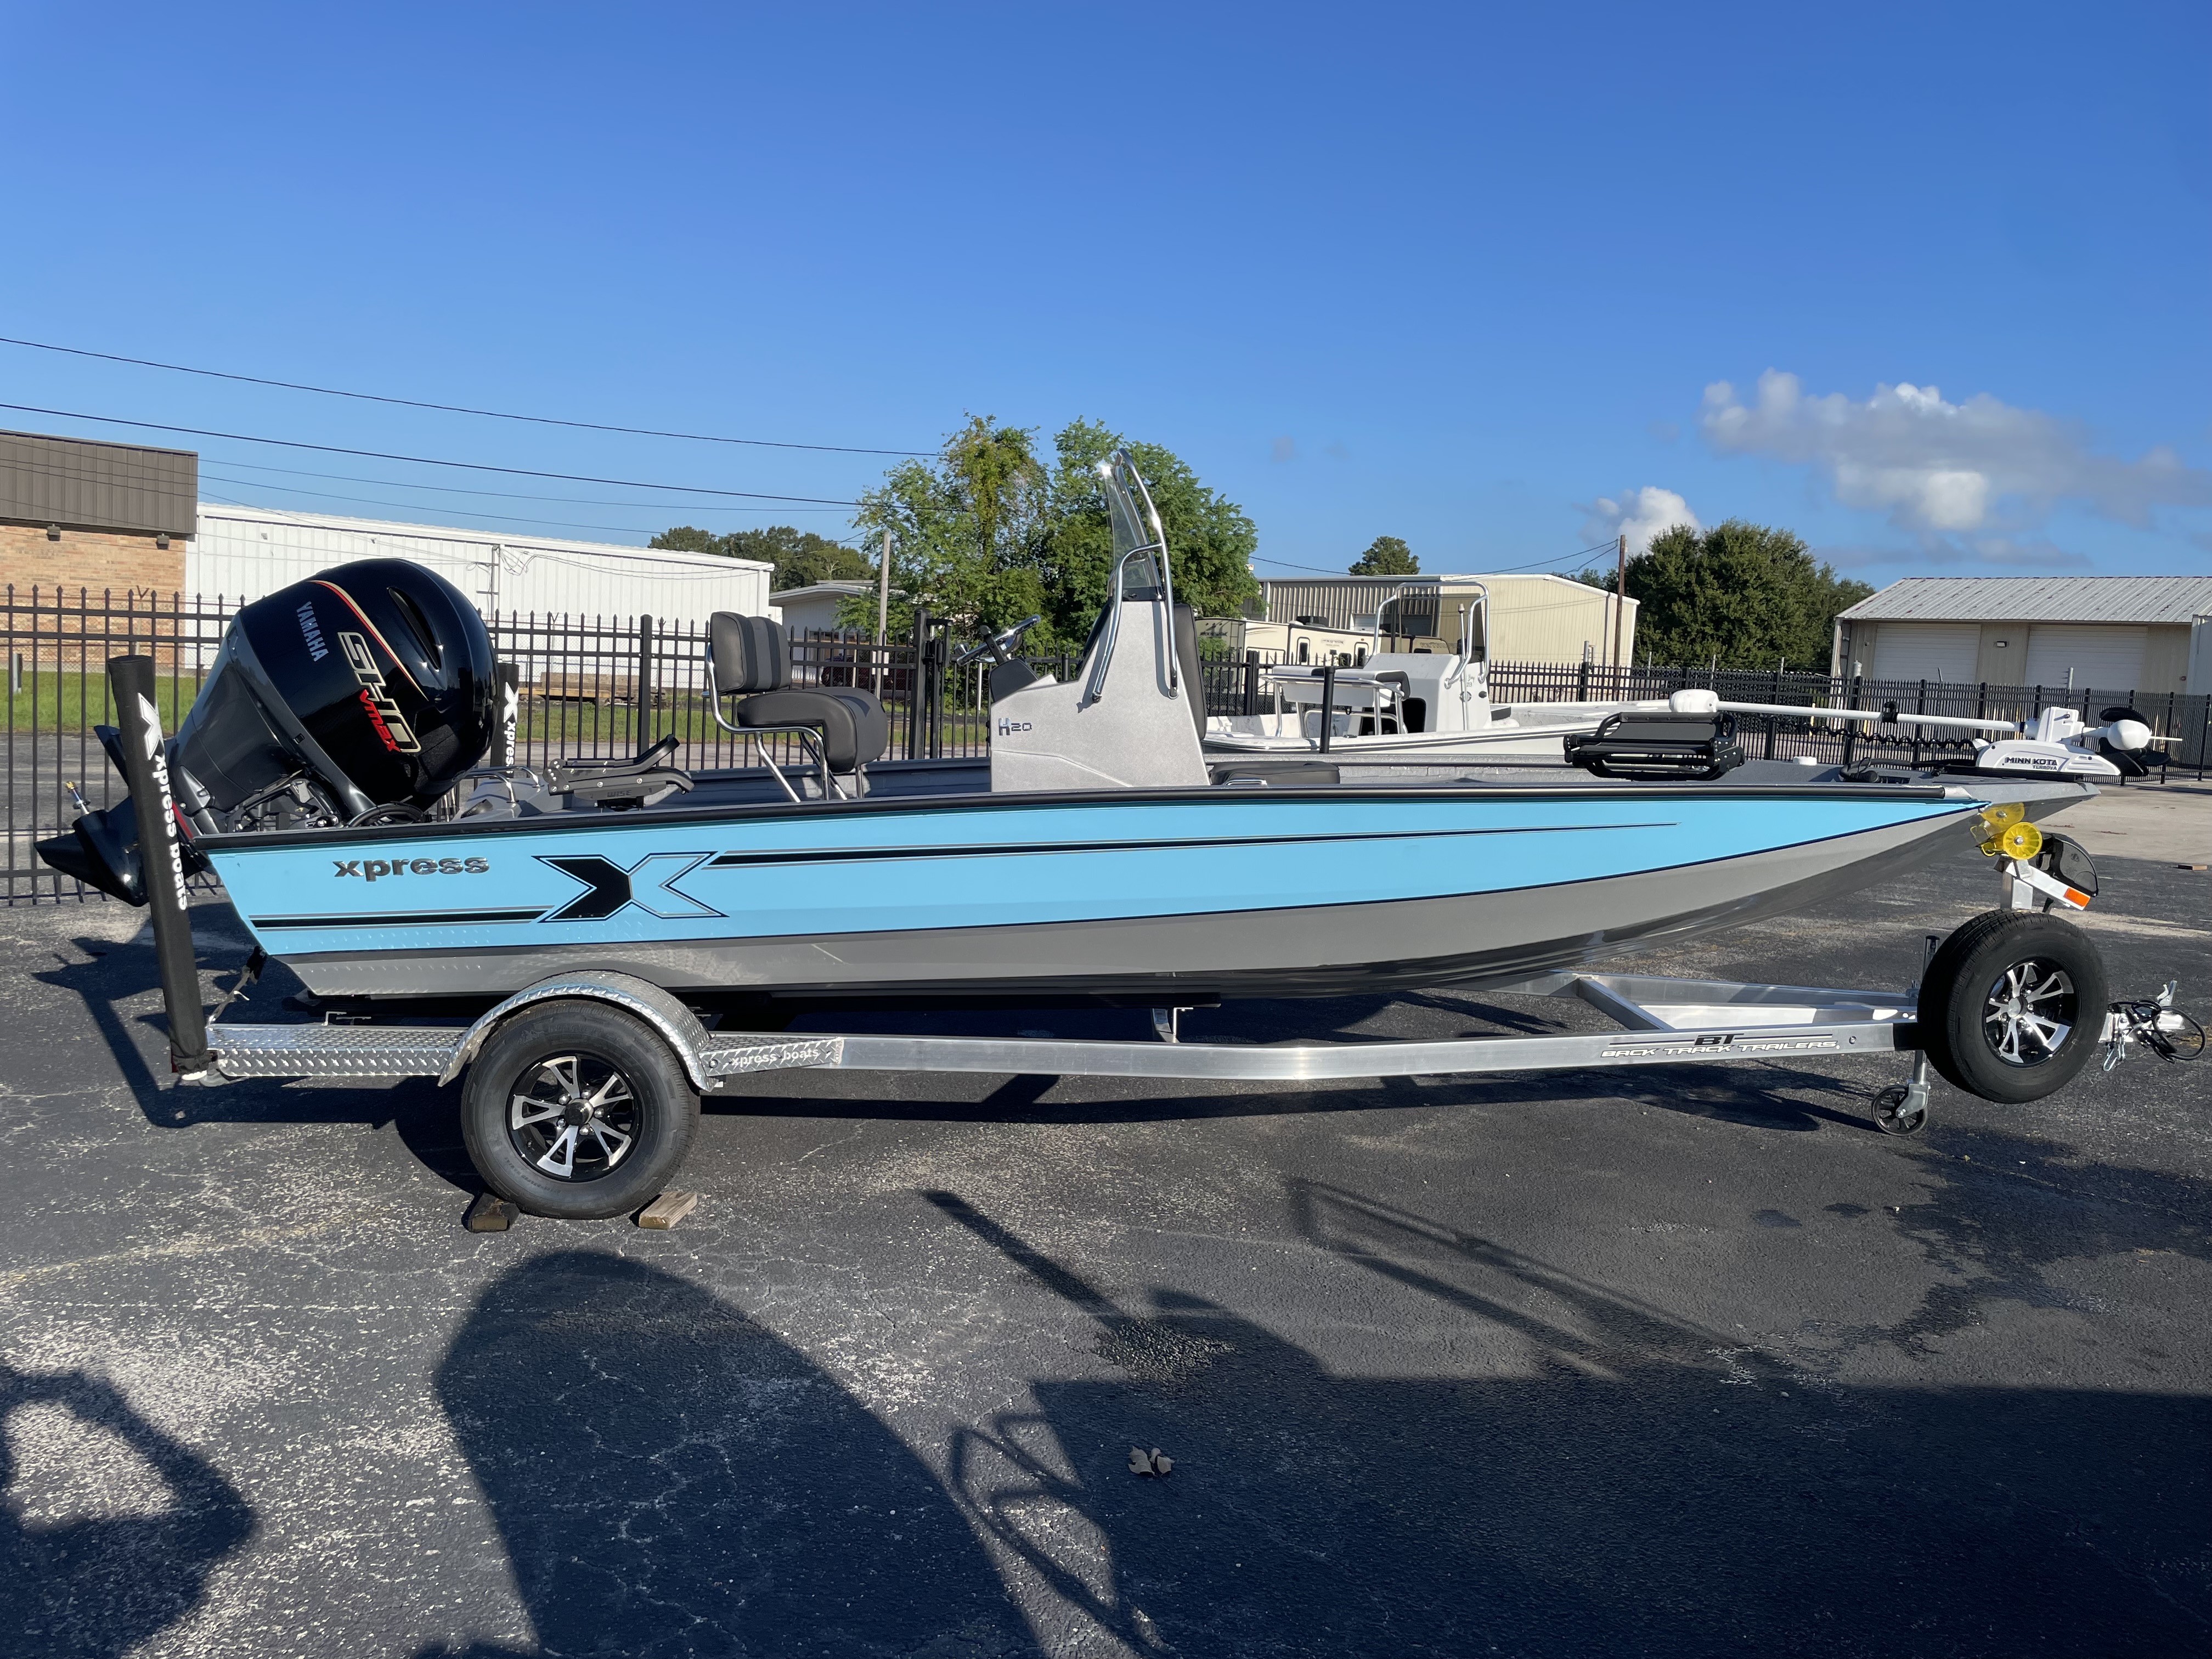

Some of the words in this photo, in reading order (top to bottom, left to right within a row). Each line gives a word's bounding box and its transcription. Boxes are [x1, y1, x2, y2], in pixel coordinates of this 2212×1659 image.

[296, 601, 329, 662] YAMAHA
[337, 632, 421, 753] SHO
[152, 753, 174, 837] xpress
[169, 842, 188, 911] boats
[332, 857, 490, 882] xpress
[1600, 1048, 1661, 1058] BACK
[1662, 1045, 1736, 1056] TRACK
[1737, 1041, 1838, 1052] TRAILERS
[1694, 1034, 1745, 1046] BT
[731, 1054, 778, 1068] xpress
[783, 1048, 820, 1060] boats
